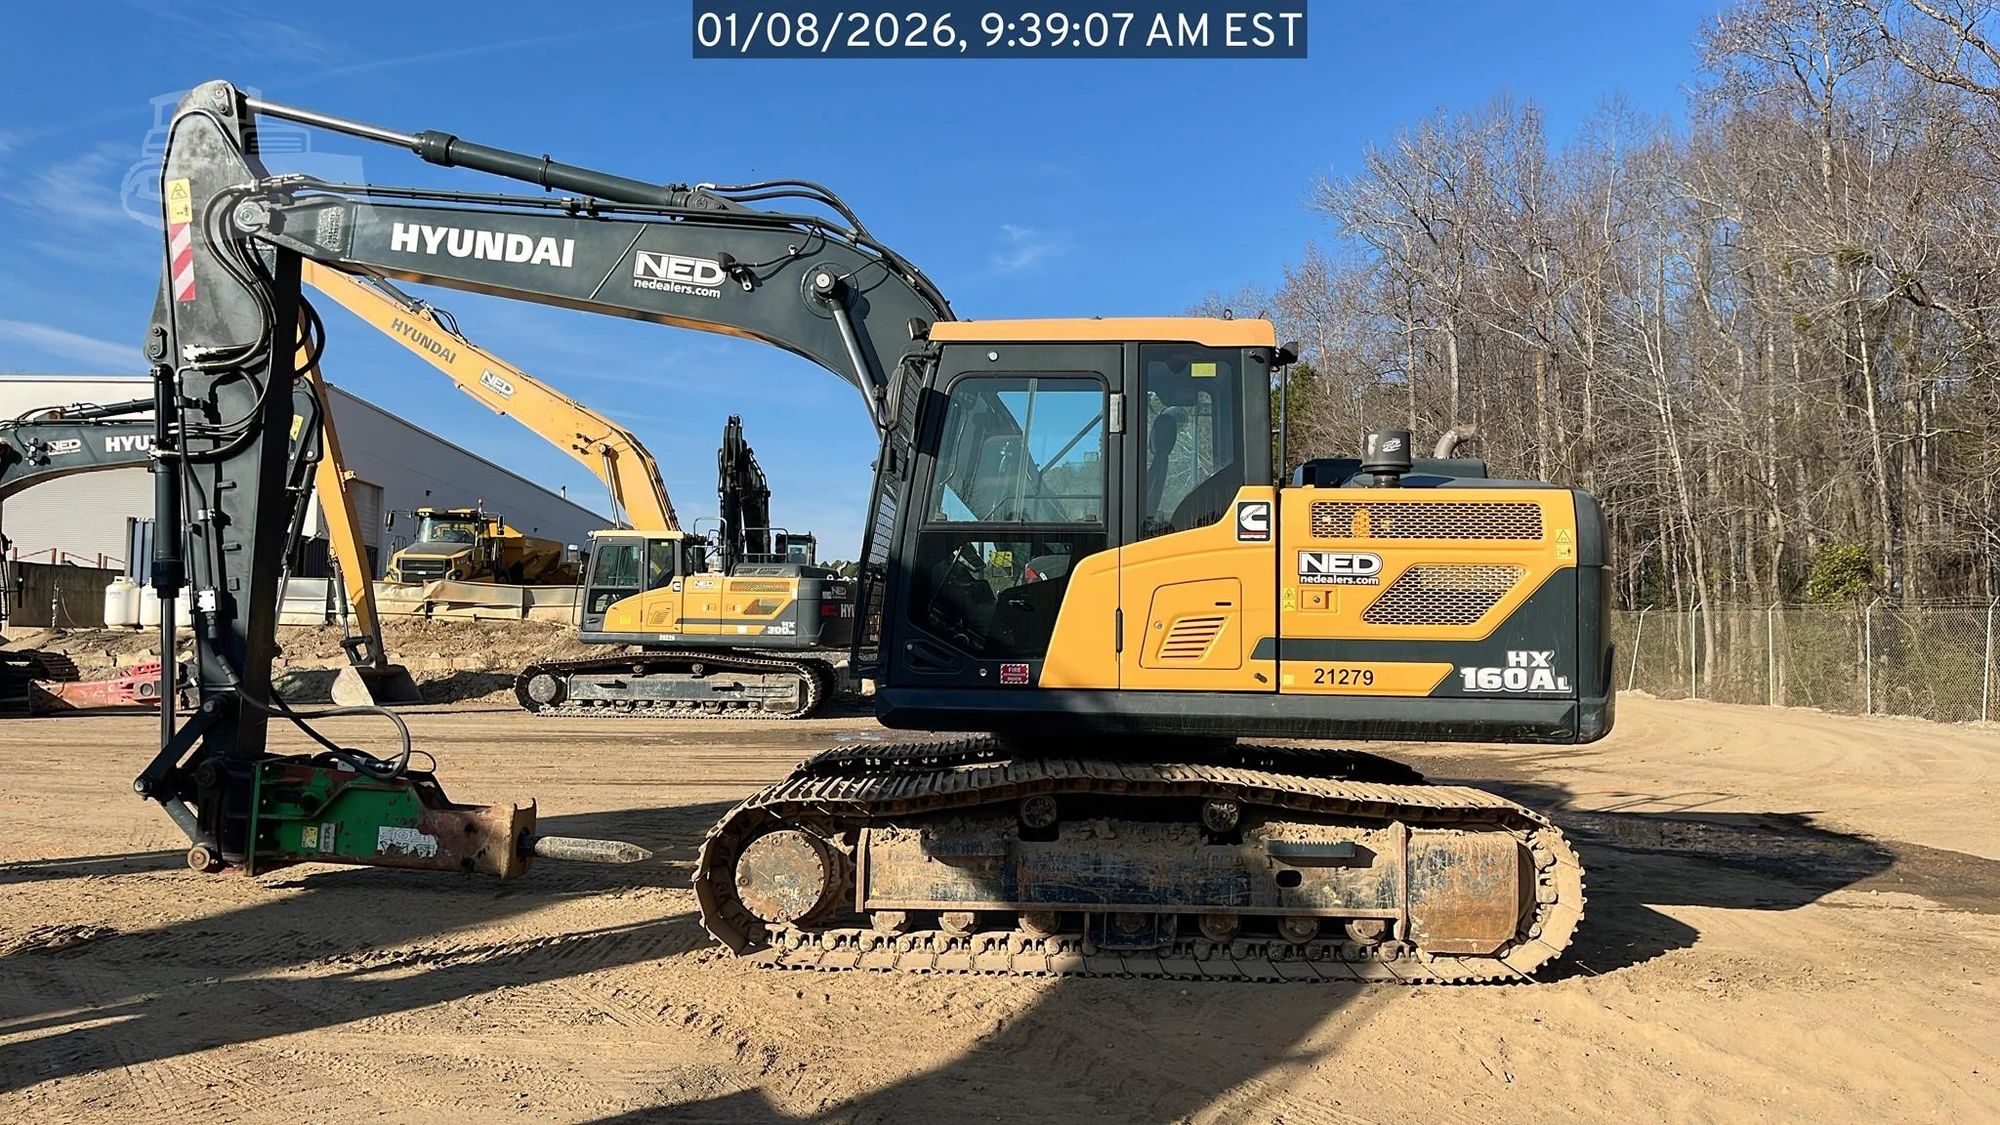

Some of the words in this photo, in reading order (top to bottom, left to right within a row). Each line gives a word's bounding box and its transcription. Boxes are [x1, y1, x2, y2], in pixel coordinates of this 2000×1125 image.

[390, 222, 575, 268] HYUNDAI
[634, 251, 726, 287] NED
[633, 278, 721, 299] nedealers.com
[391, 318, 457, 364] HYUNDAI
[480, 369, 516, 397] NED
[1299, 552, 1382, 575] NED
[1300, 574, 1379, 585] nedealers.com
[1507, 650, 1555, 668] HX
[1314, 668, 1374, 686] 21279
